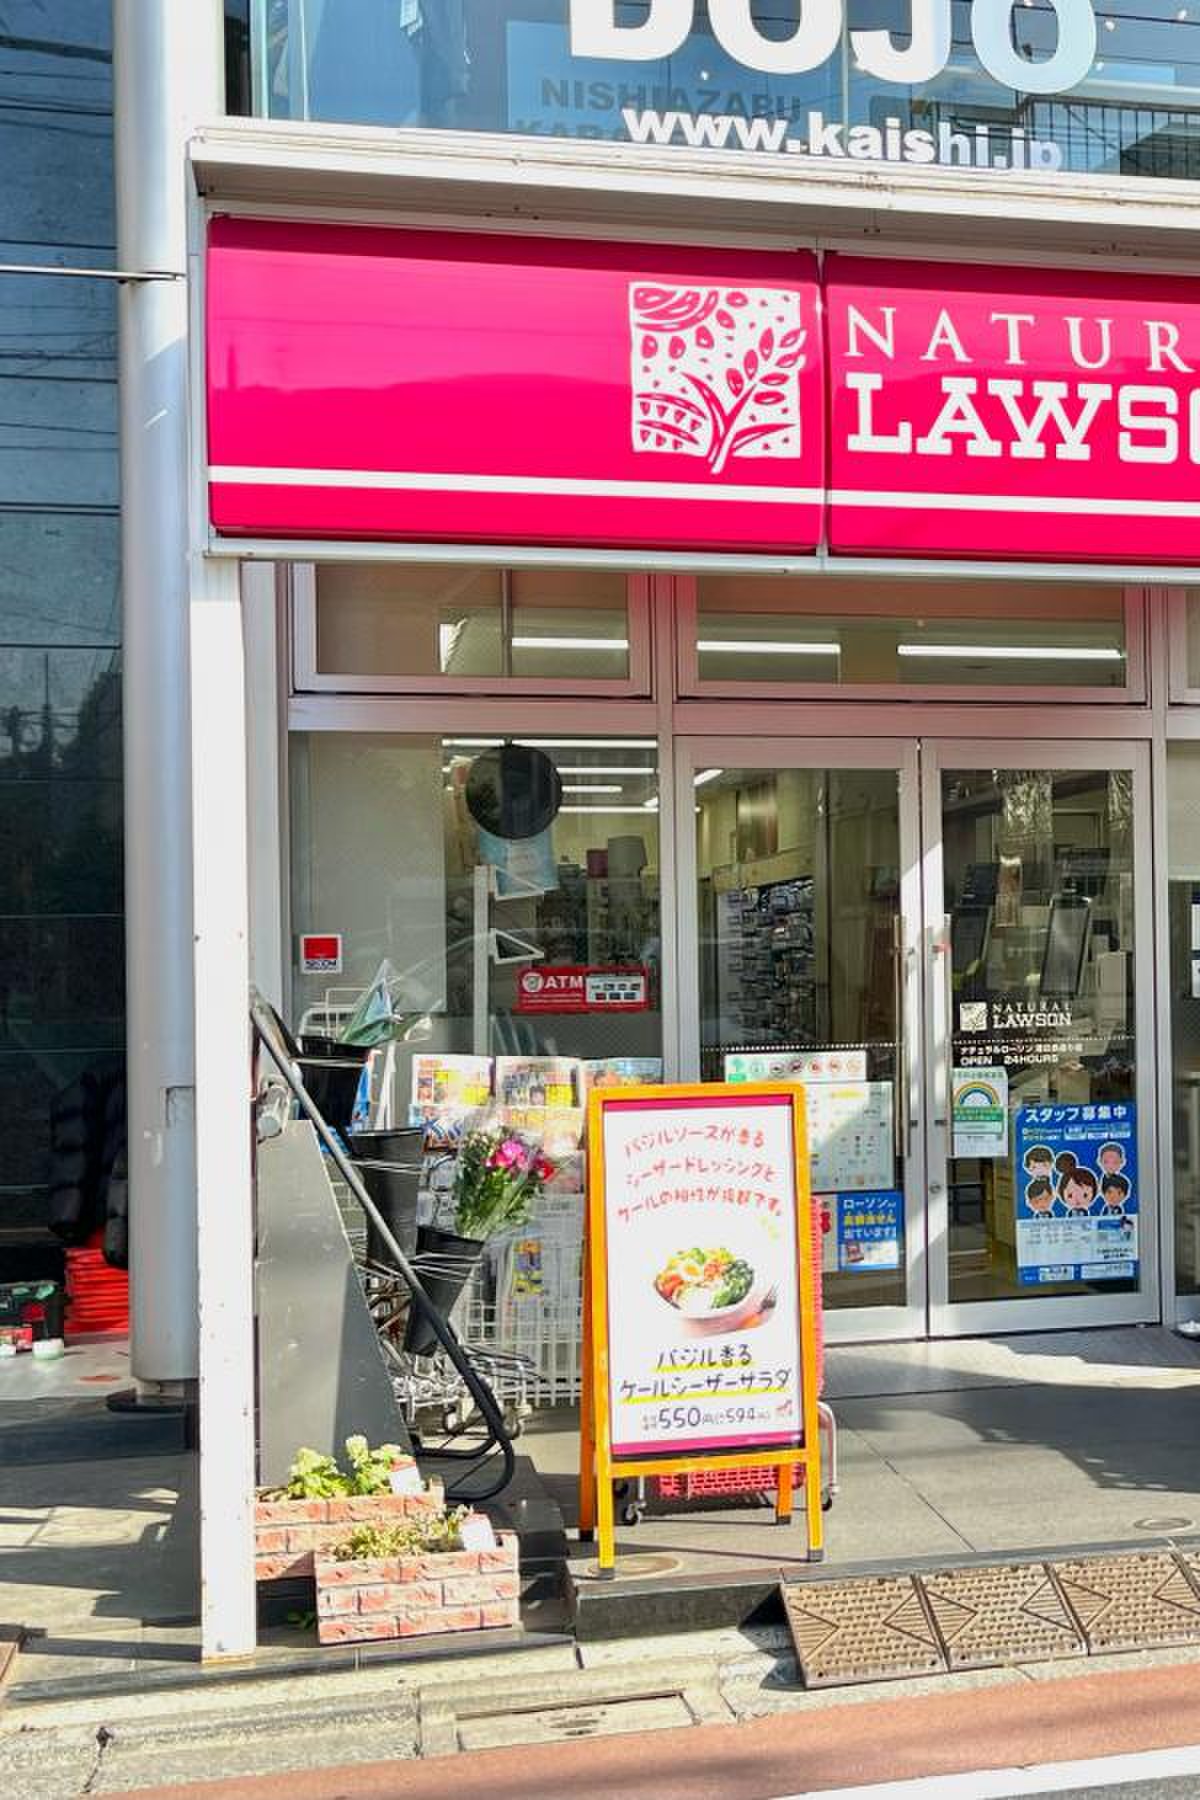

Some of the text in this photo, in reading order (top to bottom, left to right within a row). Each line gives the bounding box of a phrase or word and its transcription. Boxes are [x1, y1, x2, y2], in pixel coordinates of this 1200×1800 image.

[621, 107, 1062, 173] www.kaishi.jp
[544, 975, 583, 989] ATM
[992, 1001, 1072, 1013] NATURAL
[992, 1012, 1073, 1029] LAWSON
[960, 1056, 993, 1066] OPEN
[1025, 1104, 1127, 1123] スタッフ募集中
[626, 1157, 777, 1187] シーザードレッシングと
[656, 1344, 753, 1368] バジル香る
[619, 1368, 792, 1398] ケールシーザーサラダ
